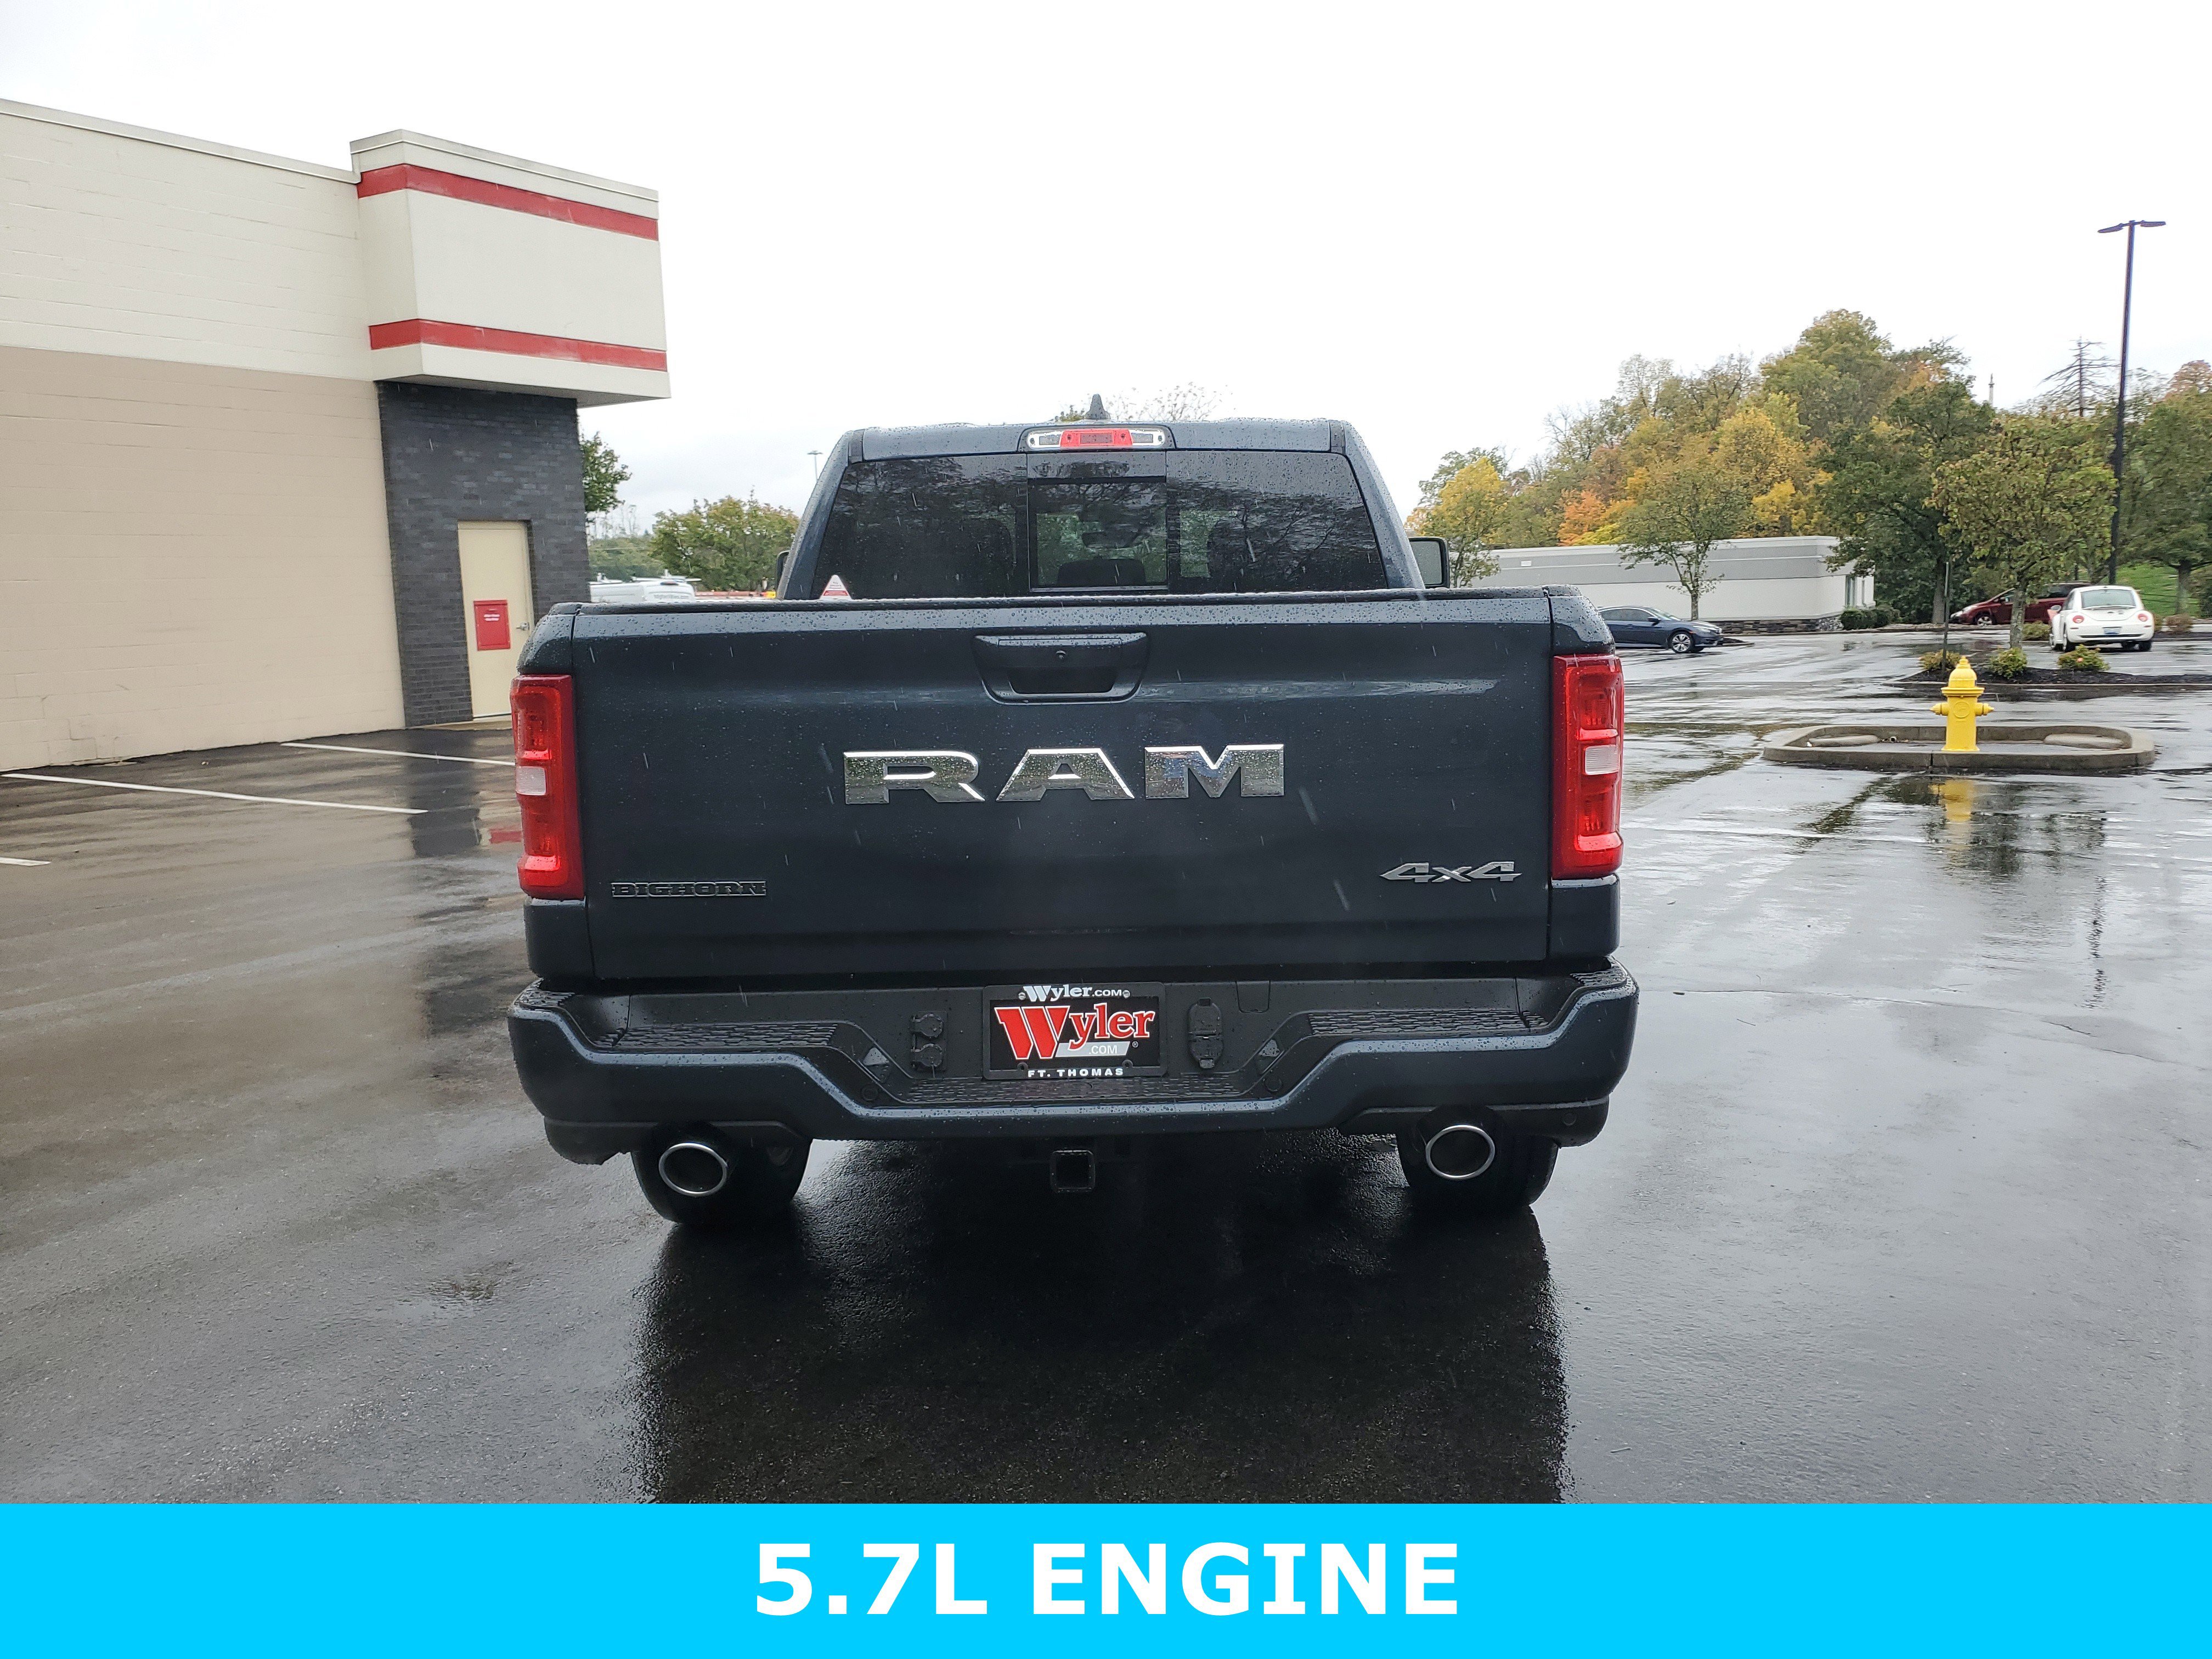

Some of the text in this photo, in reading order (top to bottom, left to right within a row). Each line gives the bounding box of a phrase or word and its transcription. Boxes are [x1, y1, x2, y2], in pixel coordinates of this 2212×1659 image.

[843, 744, 1284, 805] RAM
[1379, 861, 1522, 883] 4x4
[611, 881, 766, 898] BIGHORN
[994, 1002, 1156, 1060] Wyler
[1057, 1068, 1123, 1077] THOMAS
